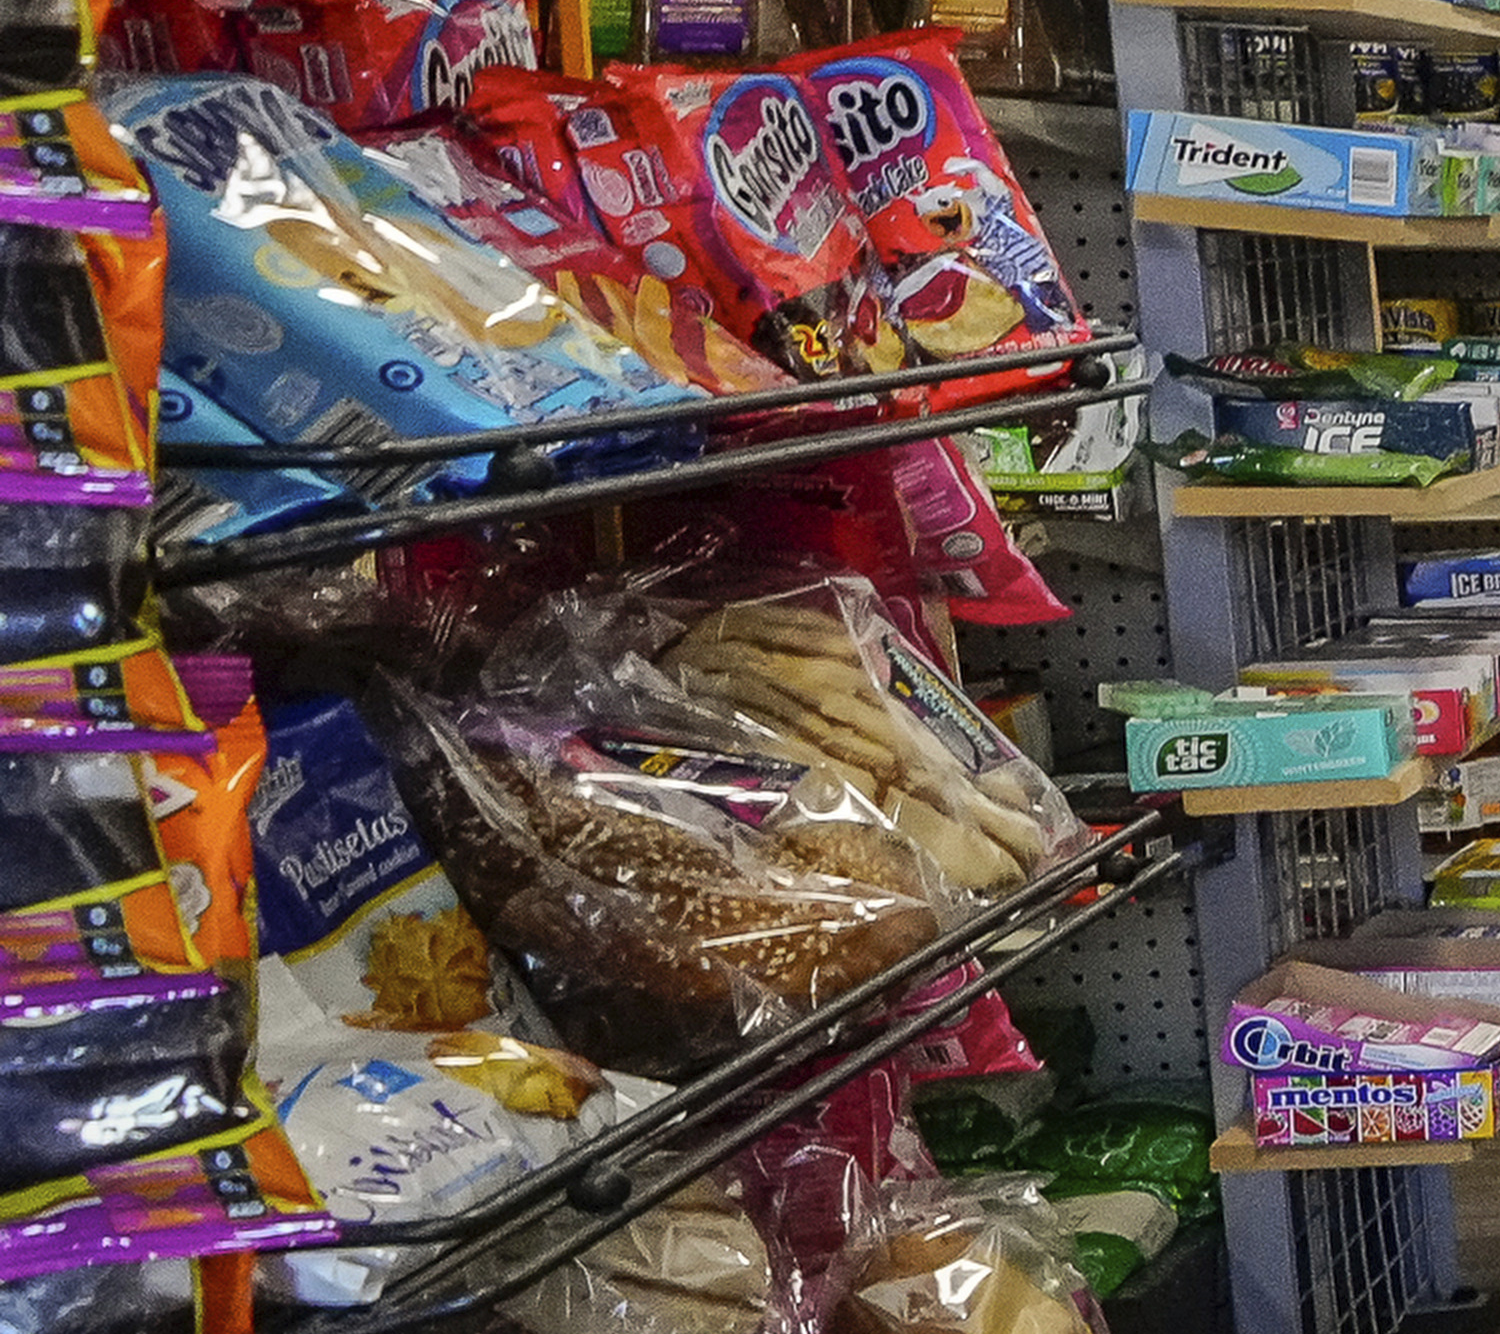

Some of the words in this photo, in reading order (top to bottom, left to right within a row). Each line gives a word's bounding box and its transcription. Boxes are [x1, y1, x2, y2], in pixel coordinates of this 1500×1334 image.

[1172, 139, 1287, 172] Trident
[1301, 425, 1386, 454] ICE
[1451, 571, 1482, 597] ICE
[1173, 735, 1216, 755] tic
[1163, 751, 1218, 774] tac
[1230, 1015, 1351, 1072] Orbit
[1270, 1083, 1417, 1109] mentos
